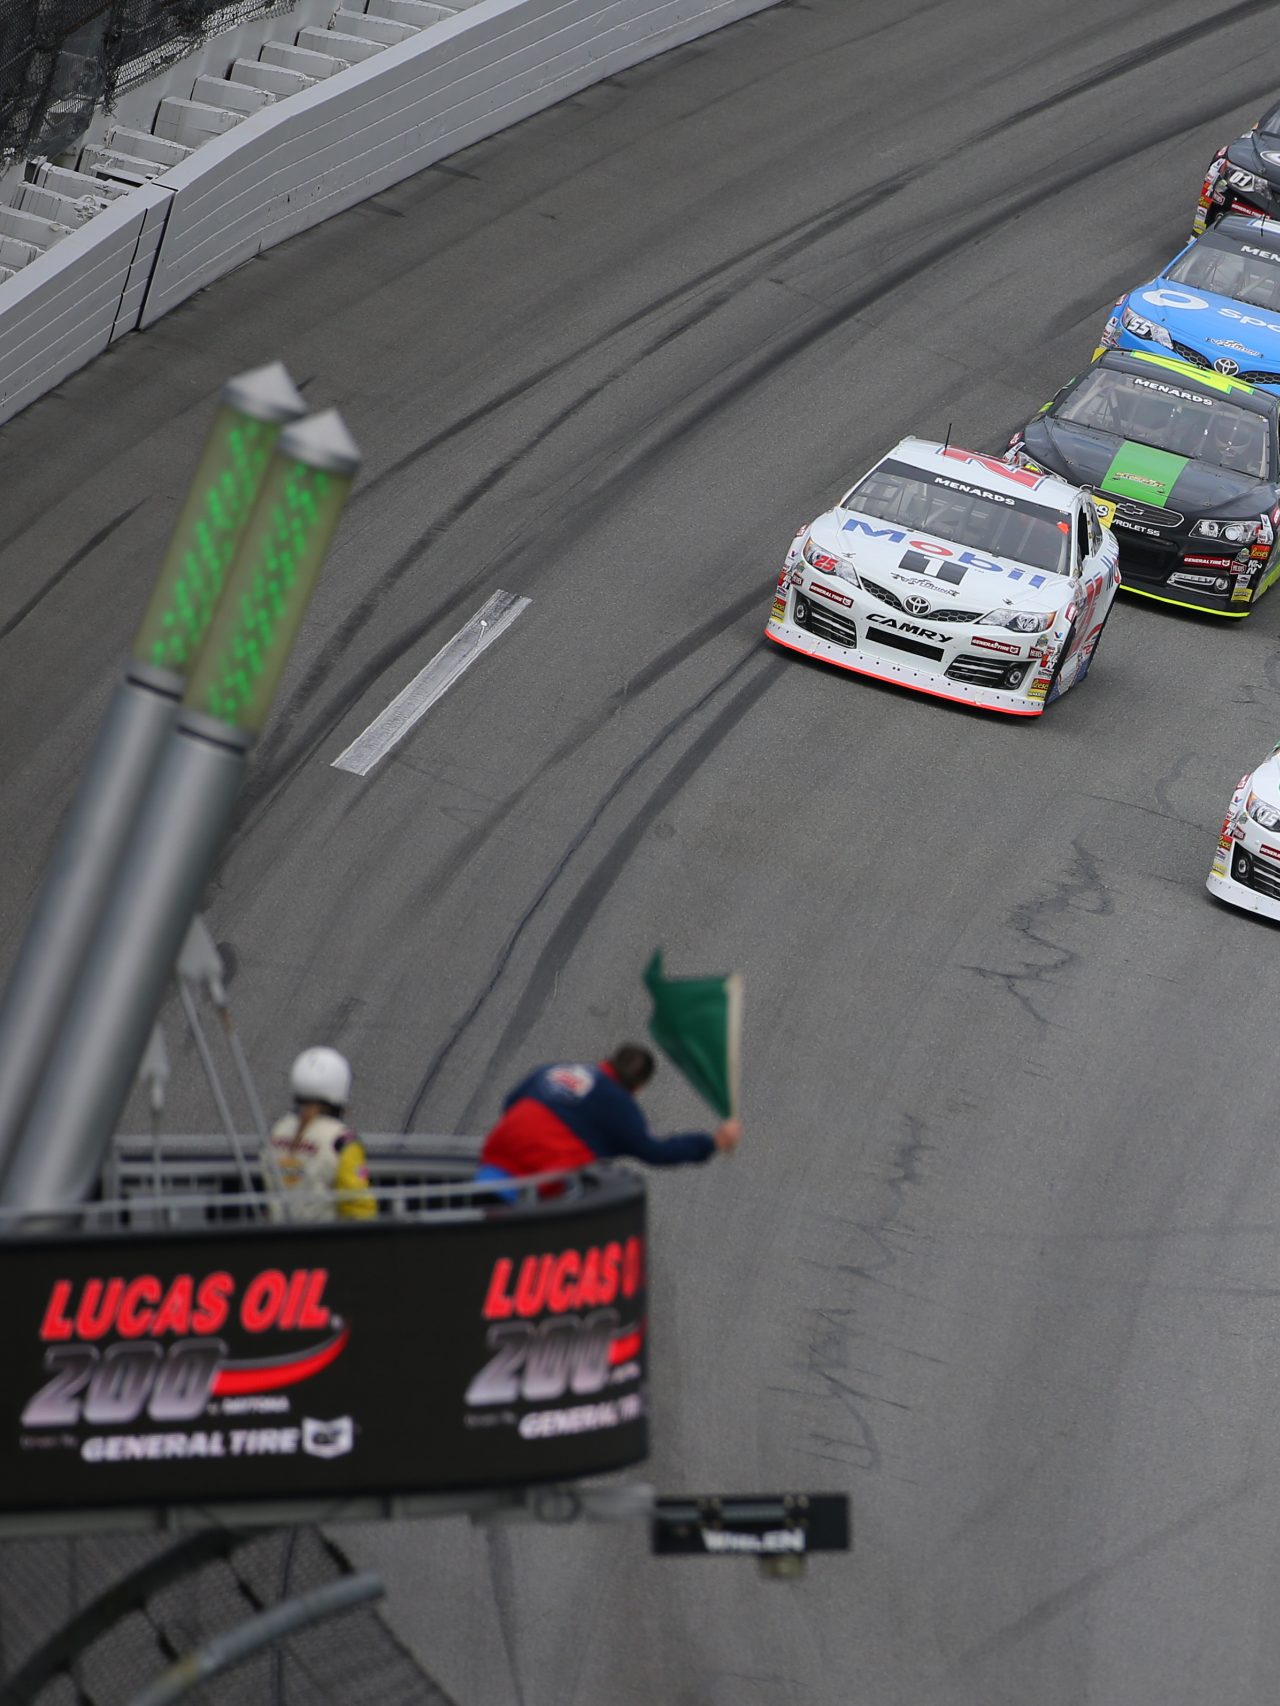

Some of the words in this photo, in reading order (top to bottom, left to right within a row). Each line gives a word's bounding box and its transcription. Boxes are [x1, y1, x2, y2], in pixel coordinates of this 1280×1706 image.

[1229, 171, 1252, 187] 01
[1127, 319, 1153, 336] 55
[1134, 378, 1213, 406] MENARDS
[934, 477, 1016, 506] MENARDS
[813, 555, 838, 571] 25
[842, 519, 1046, 589] Mobil
[866, 613, 954, 643] CAMRY
[482, 1241, 622, 1319] LUCAS
[39, 1272, 235, 1341] LUCAS
[240, 1268, 331, 1334] OIL
[464, 1306, 621, 1407] 200
[20, 1337, 228, 1428] 200
[518, 1402, 618, 1440] GENERAL
[80, 1431, 224, 1462] GENERAL
[229, 1427, 301, 1456] TIRE
